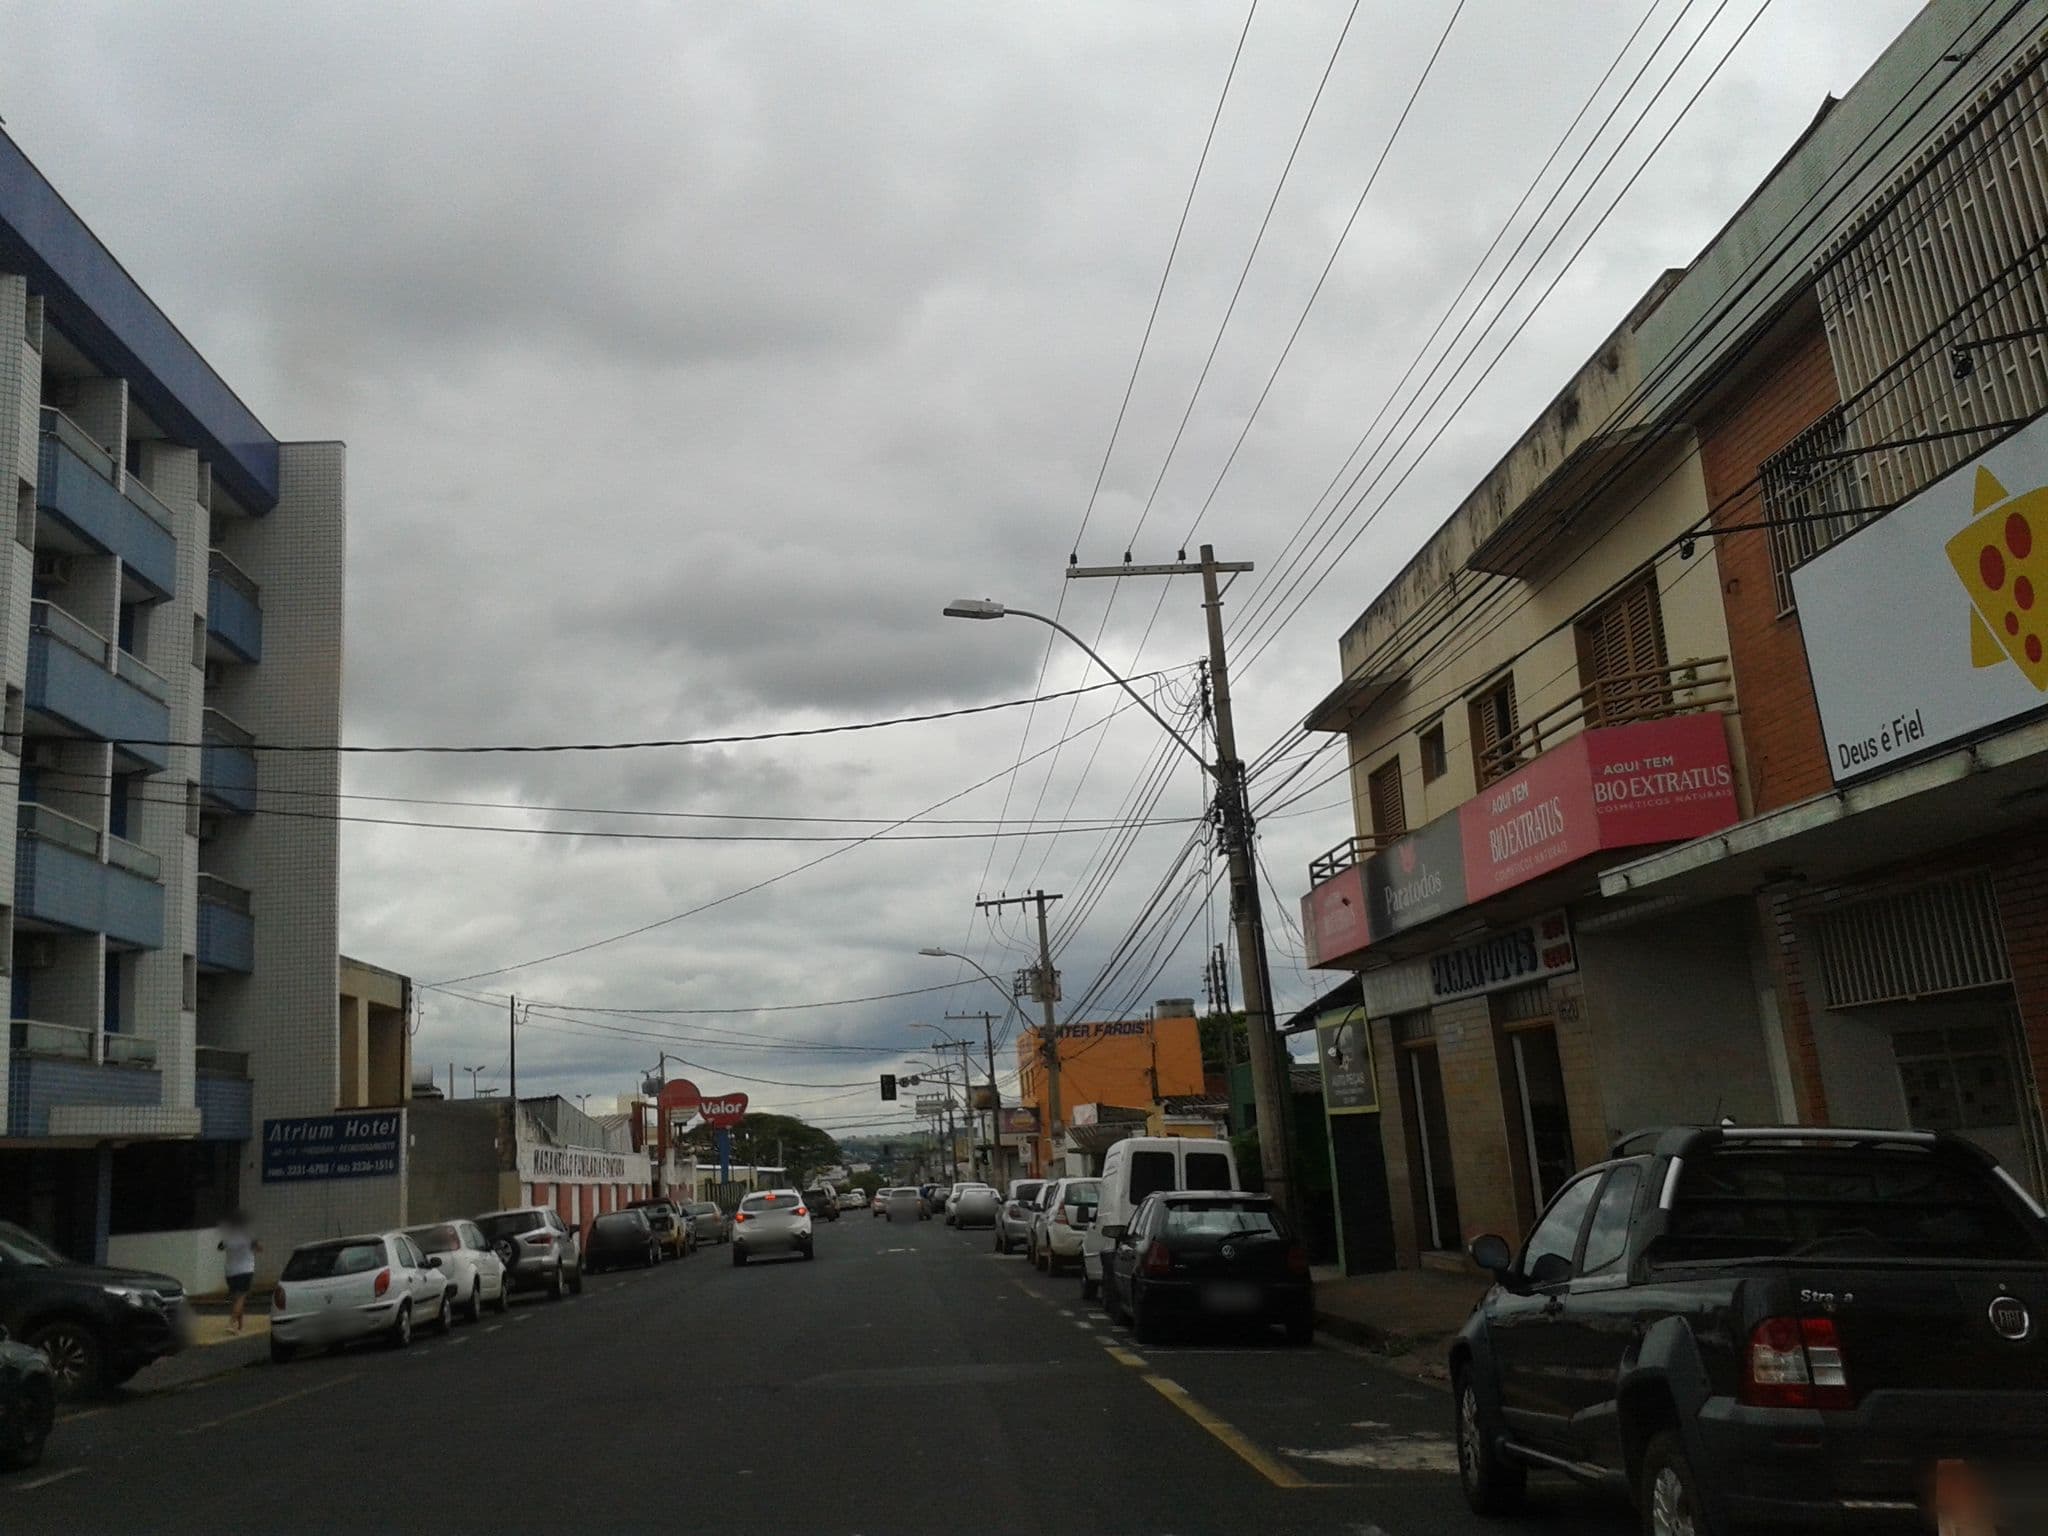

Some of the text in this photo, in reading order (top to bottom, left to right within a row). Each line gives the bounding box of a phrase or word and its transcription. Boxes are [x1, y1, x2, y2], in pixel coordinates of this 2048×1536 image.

[1838, 708, 1925, 769] Deus é Fiel
[1604, 755, 1674, 775] AQUI TEM
[1594, 764, 1730, 803] BIO EXTRATUS
[1675, 789, 1732, 803] NATURAIS
[1491, 780, 1529, 816] AQUI TEM
[1384, 864, 1442, 915] Paratodos
[701, 1101, 743, 1114] Valor
[269, 1117, 397, 1142] Atrium Hotel
[1998, 1310, 2020, 1328] FIAT
